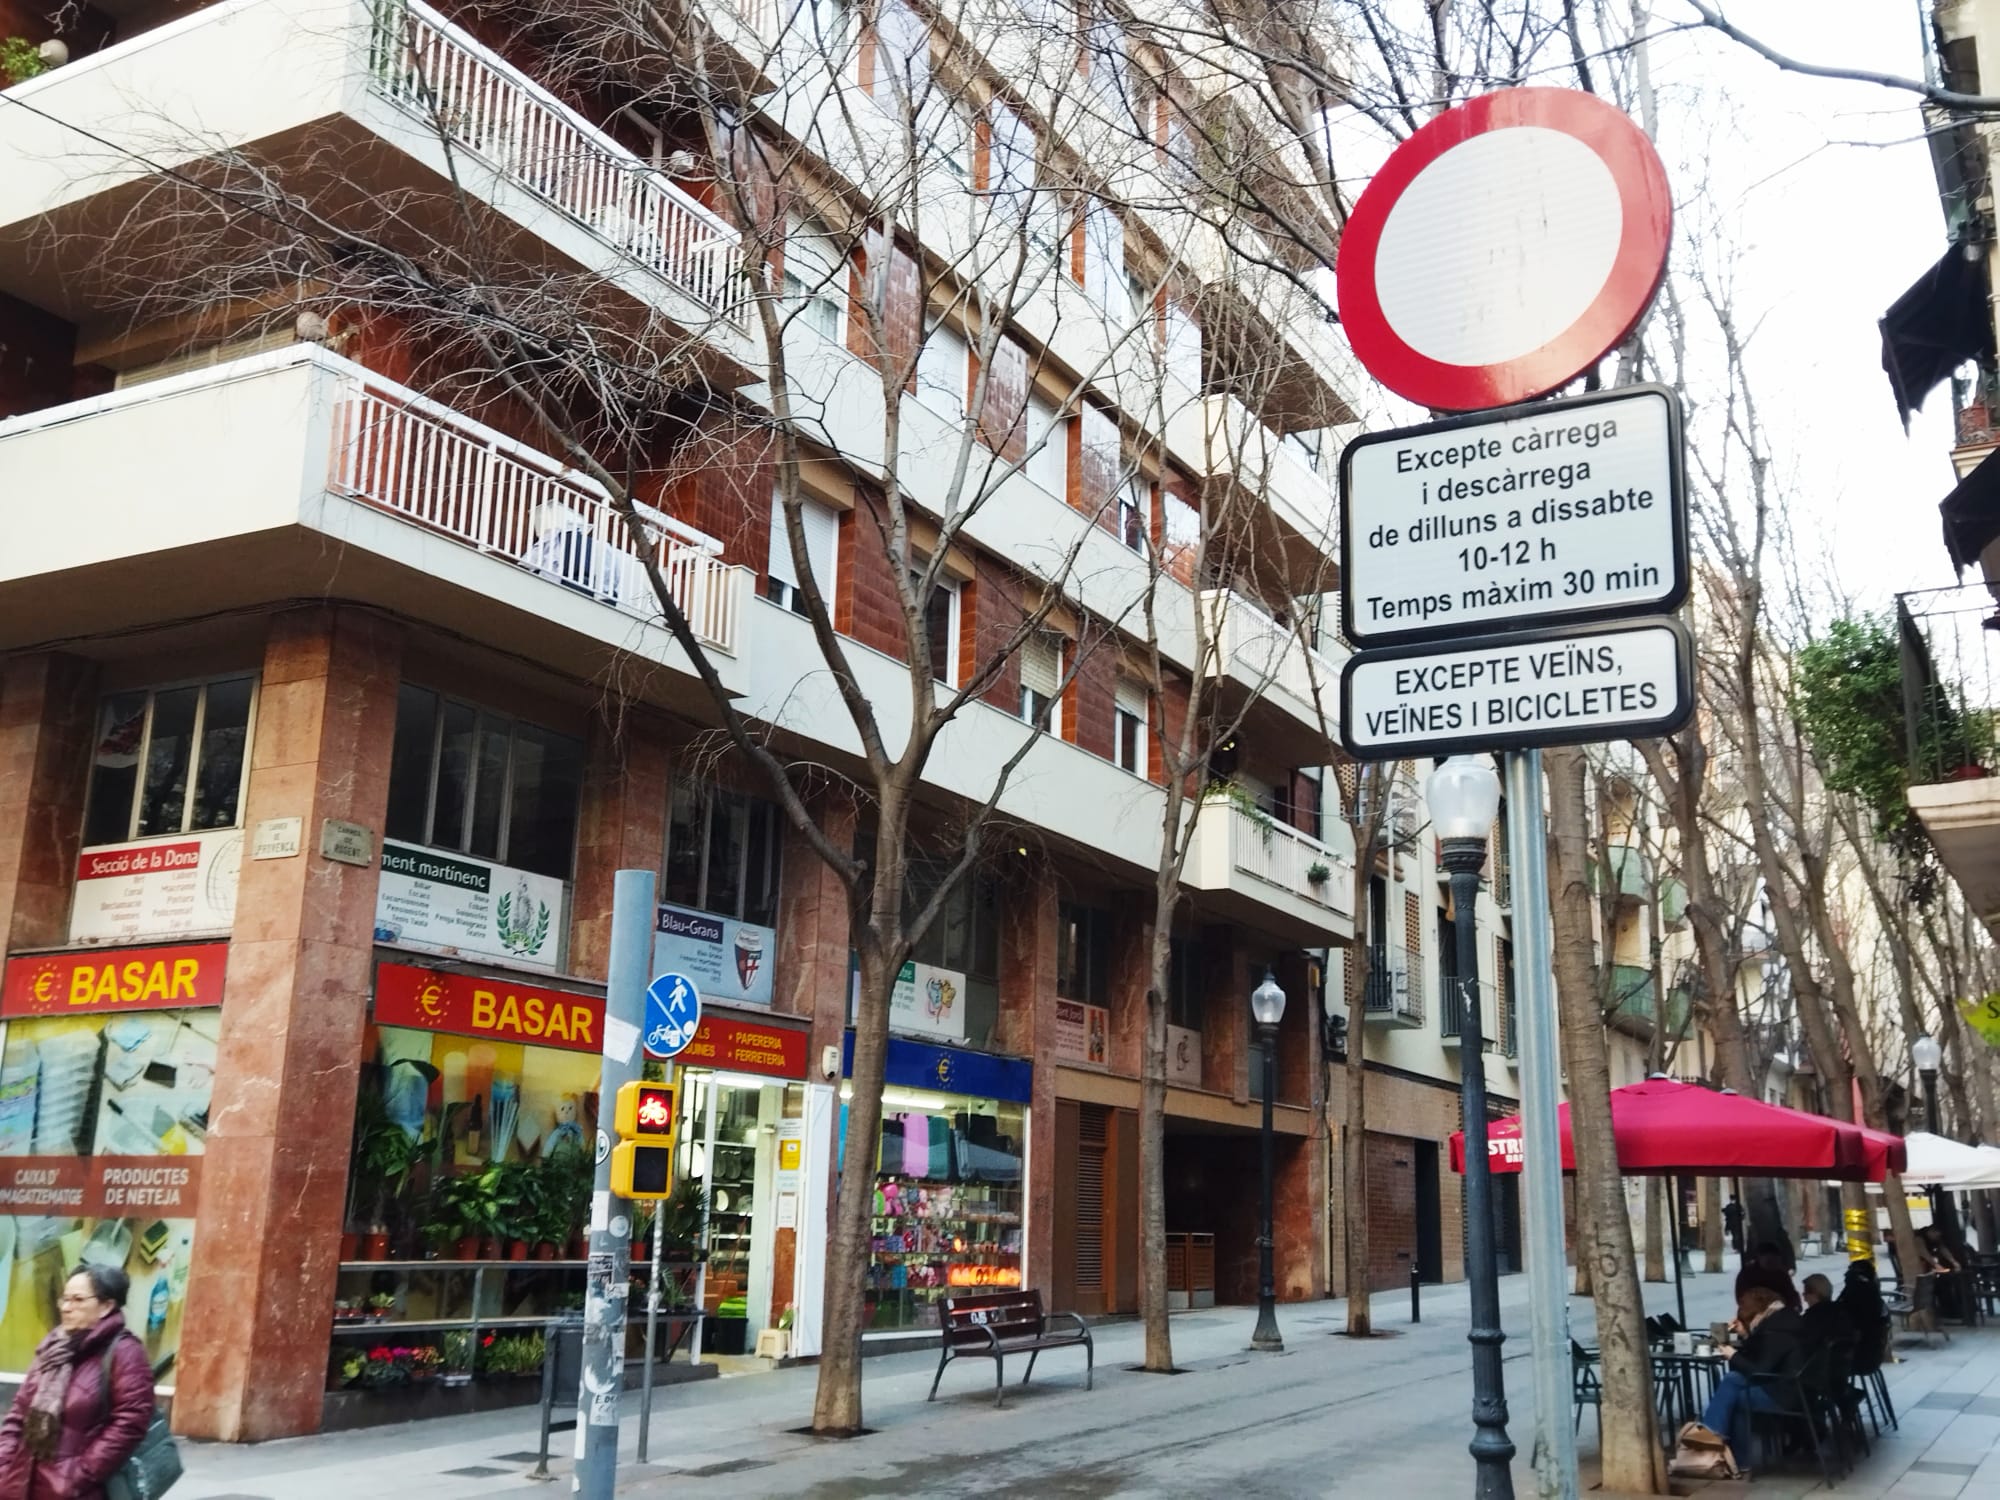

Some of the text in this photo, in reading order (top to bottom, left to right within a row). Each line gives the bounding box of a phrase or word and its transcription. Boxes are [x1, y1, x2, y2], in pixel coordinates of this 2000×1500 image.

[1397, 418, 1618, 473] Excepte càrrega
[1422, 459, 1591, 505] i descàrrega
[1369, 487, 1654, 549] de dilluns a dissabte
[1458, 537, 1556, 573] 10-12 h
[1367, 563, 1660, 621] Temps màxim 30 min
[1395, 643, 1624, 696] EXCEPTE VEÏNS,
[1366, 681, 1658, 737] VEÏNES I BICICLETES
[89, 848, 199, 875] Secció de la Dona
[662, 914, 719, 940] Blau-Grana
[68, 958, 199, 1005] BASAR
[471, 989, 593, 1044] BASAR
[735, 1031, 783, 1051] PAPERERIA
[735, 1048, 786, 1068] FERRETERIA
[103, 1168, 190, 1186] PRODUCTES
[105, 1188, 181, 1206] DE NETEJA
